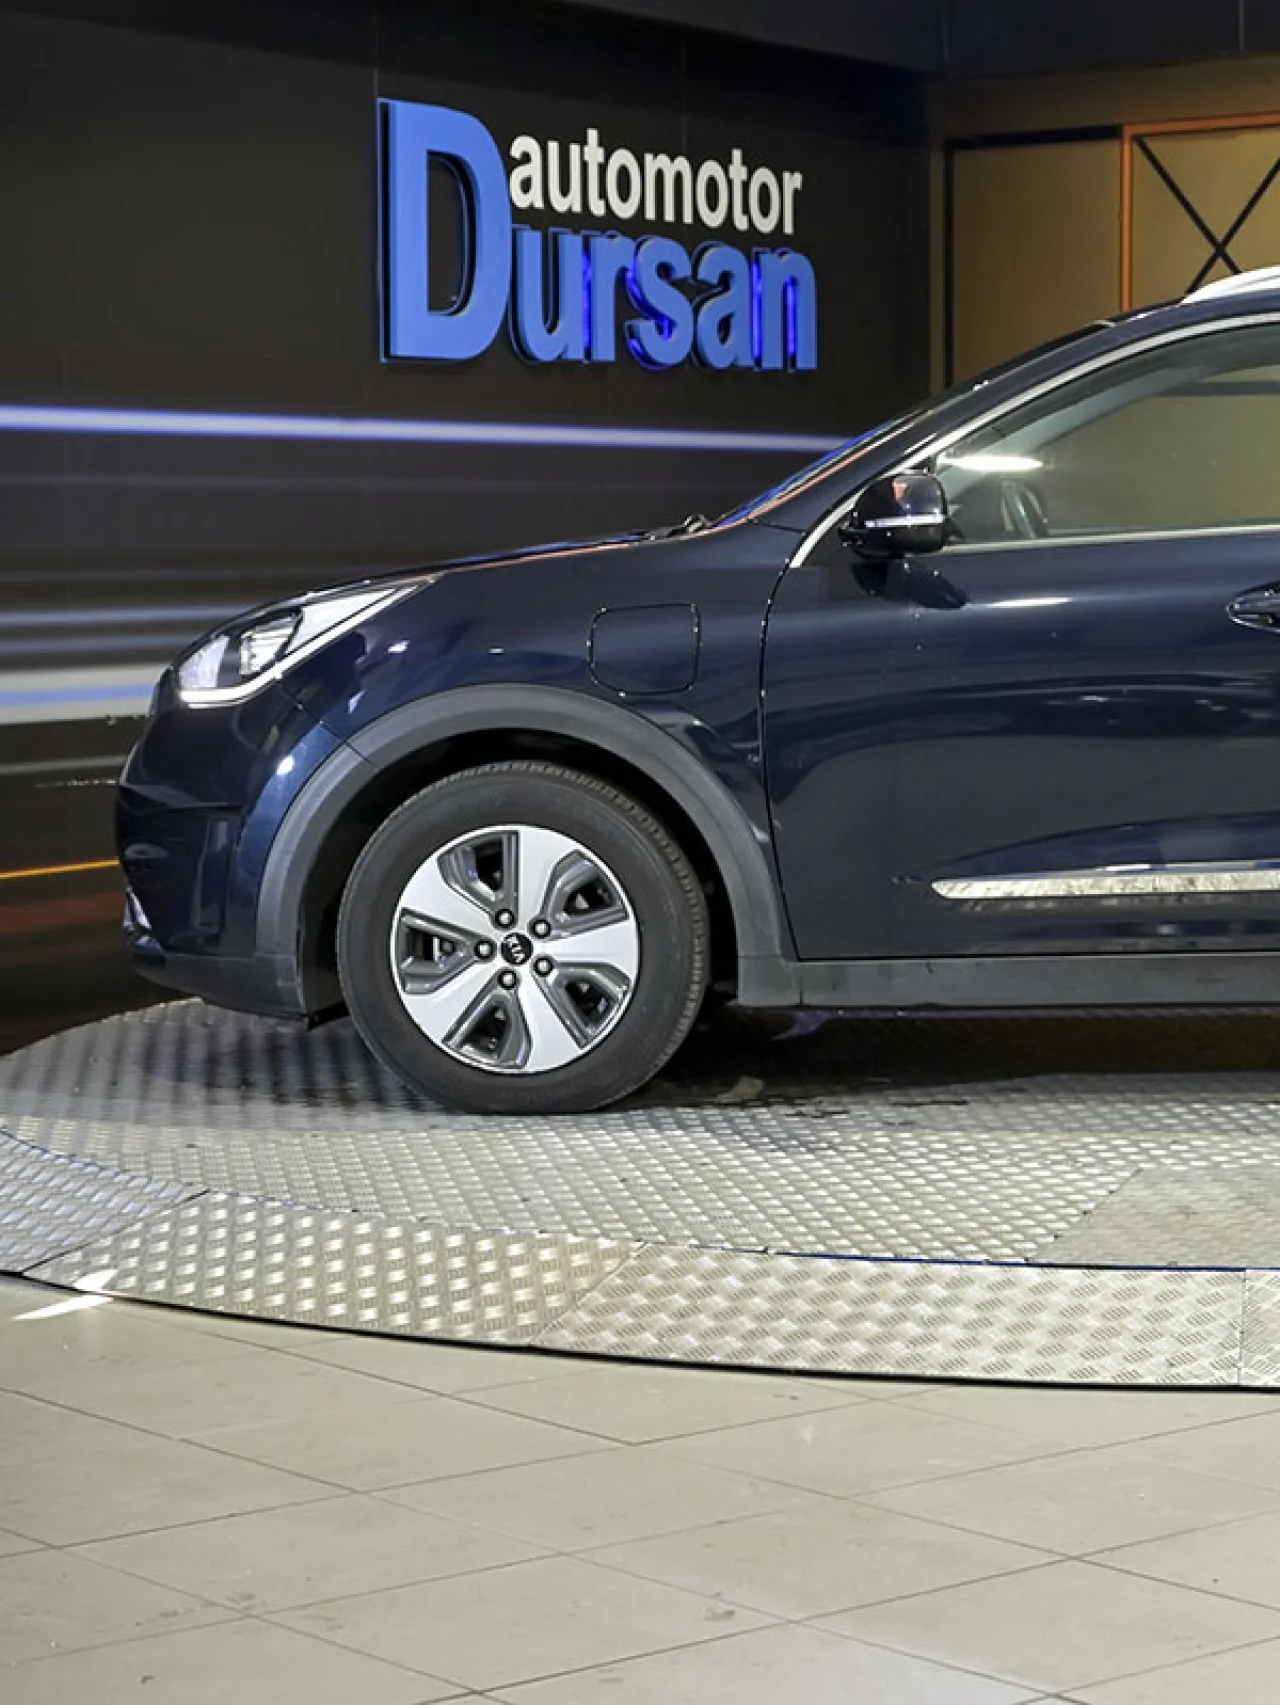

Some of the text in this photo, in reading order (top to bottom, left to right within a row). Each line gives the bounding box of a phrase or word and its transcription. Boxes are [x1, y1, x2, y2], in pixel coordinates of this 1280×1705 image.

[377, 98, 817, 371] Dursan
[509, 128, 802, 235] automotor
[506, 936, 526, 963] KIA
